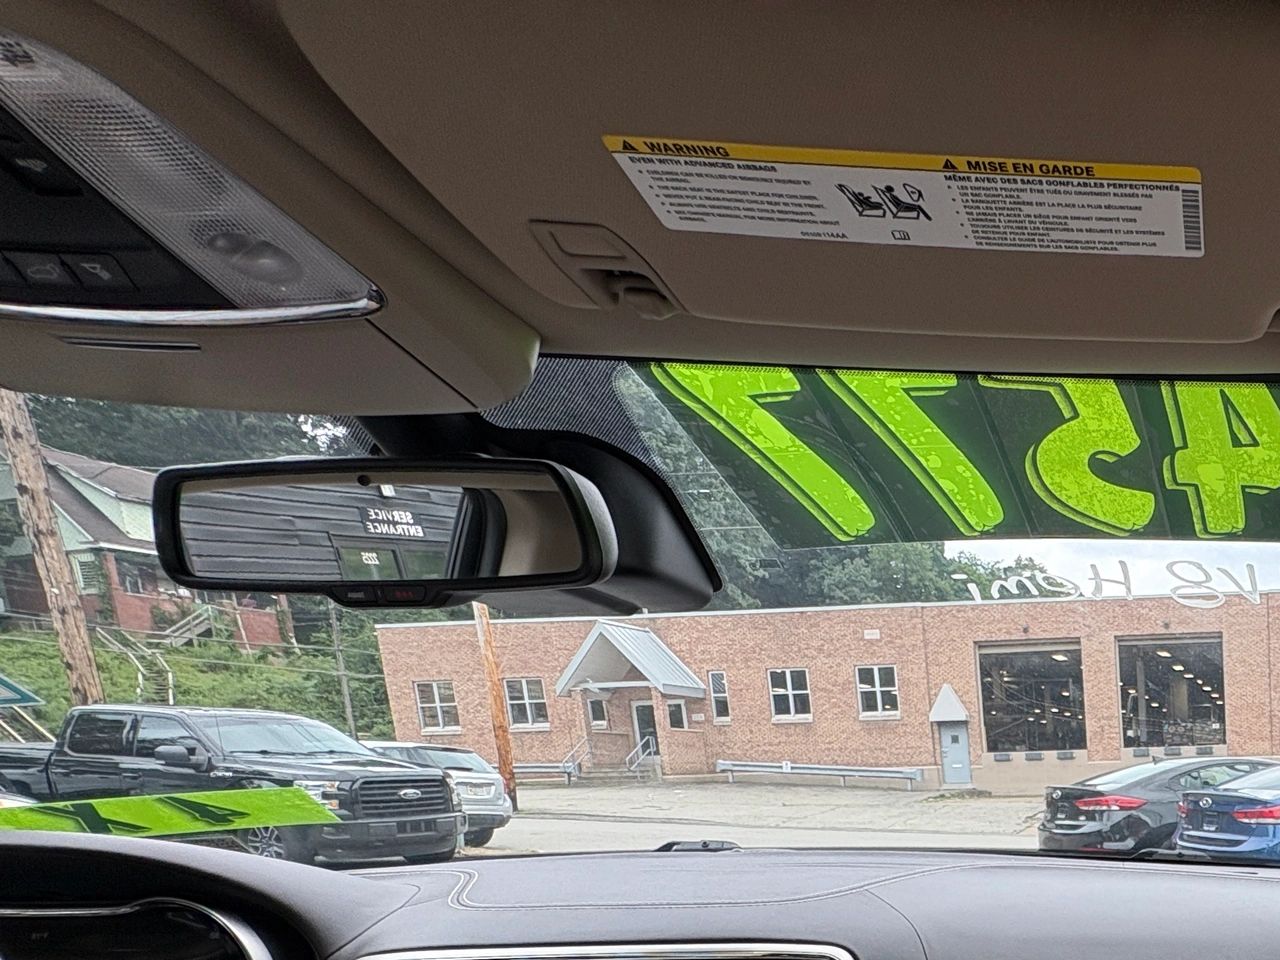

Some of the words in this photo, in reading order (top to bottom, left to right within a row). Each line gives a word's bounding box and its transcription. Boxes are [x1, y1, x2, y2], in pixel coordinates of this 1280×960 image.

[643, 140, 729, 158] WARNING
[967, 160, 1009, 173] MISE
[1012, 162, 1035, 174] EN
[1038, 164, 1096, 177] GARDE
[974, 175, 998, 183] AVEC
[1045, 178, 1104, 188] GONFLABLES
